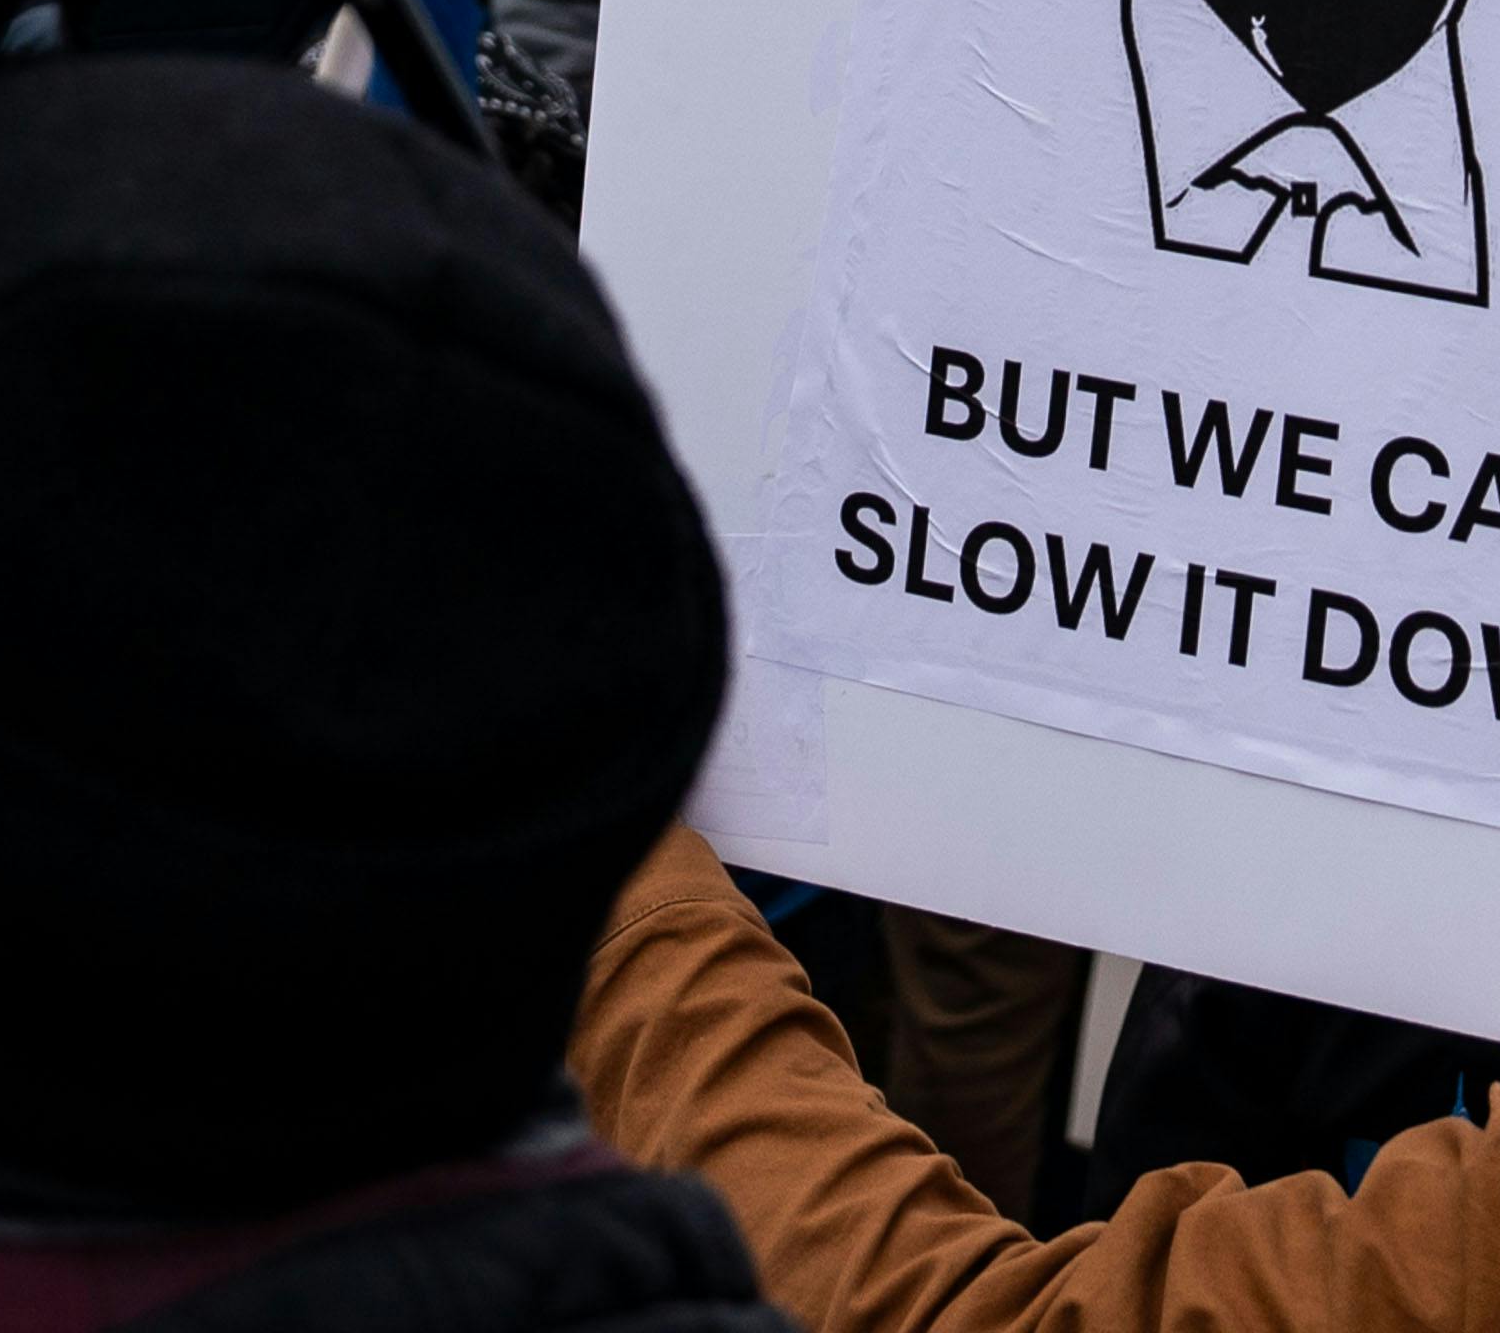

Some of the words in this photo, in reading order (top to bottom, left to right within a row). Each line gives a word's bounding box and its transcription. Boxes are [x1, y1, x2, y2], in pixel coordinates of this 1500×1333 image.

[924, 345, 1137, 471] BUT
[1161, 389, 1340, 516] WE
[834, 491, 1156, 641] SLOW
[1179, 562, 1277, 668] IT
